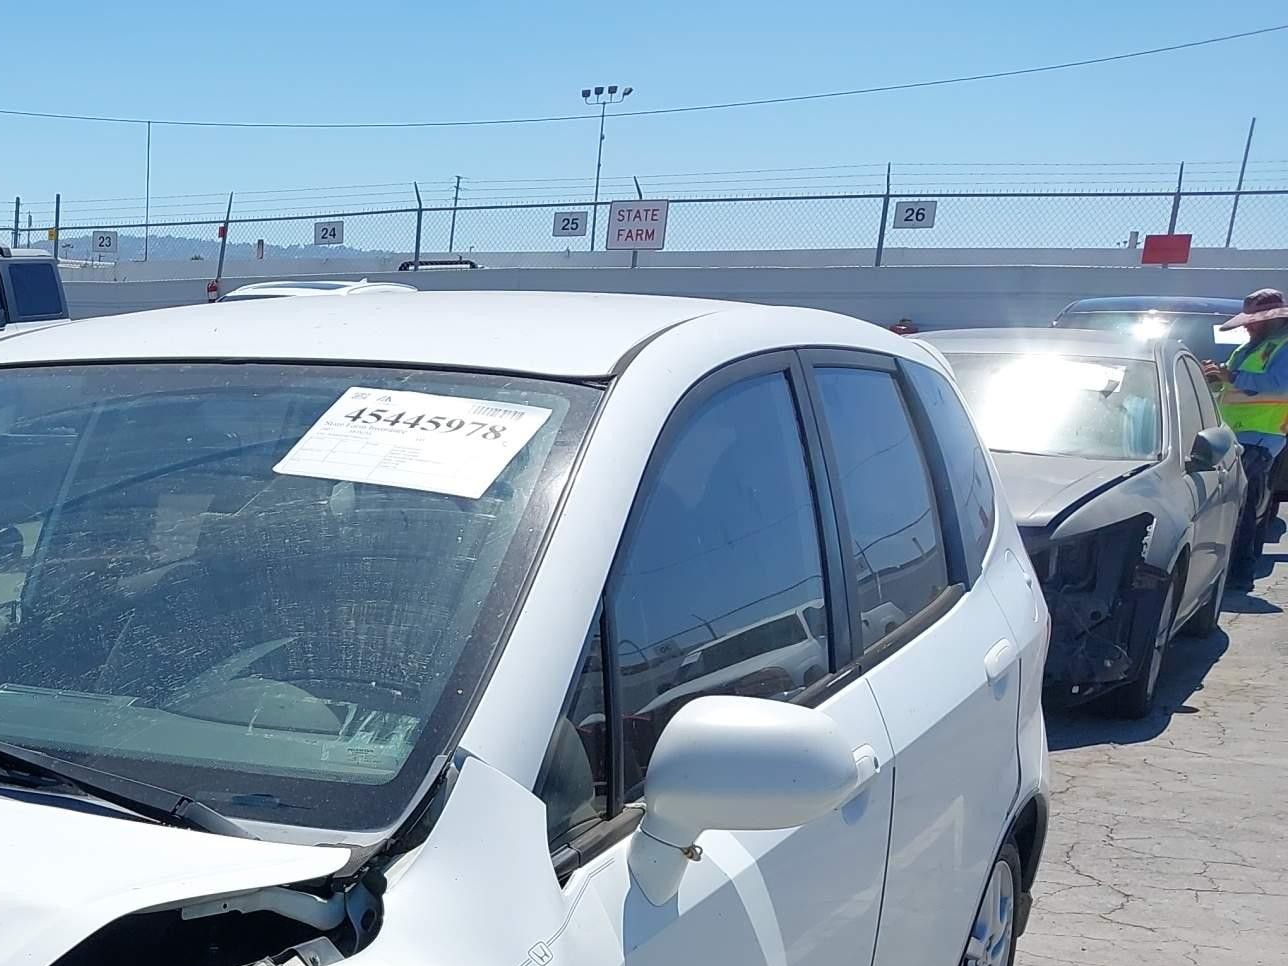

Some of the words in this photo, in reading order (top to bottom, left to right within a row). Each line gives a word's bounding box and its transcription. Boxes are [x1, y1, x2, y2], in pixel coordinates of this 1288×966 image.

[617, 208, 660, 222] STATE
[903, 207, 926, 222] 26
[561, 217, 579, 231] 25
[321, 226, 337, 239] 24
[616, 228, 655, 241] FARM
[98, 235, 112, 248] 23
[344, 406, 507, 440] 45445978
